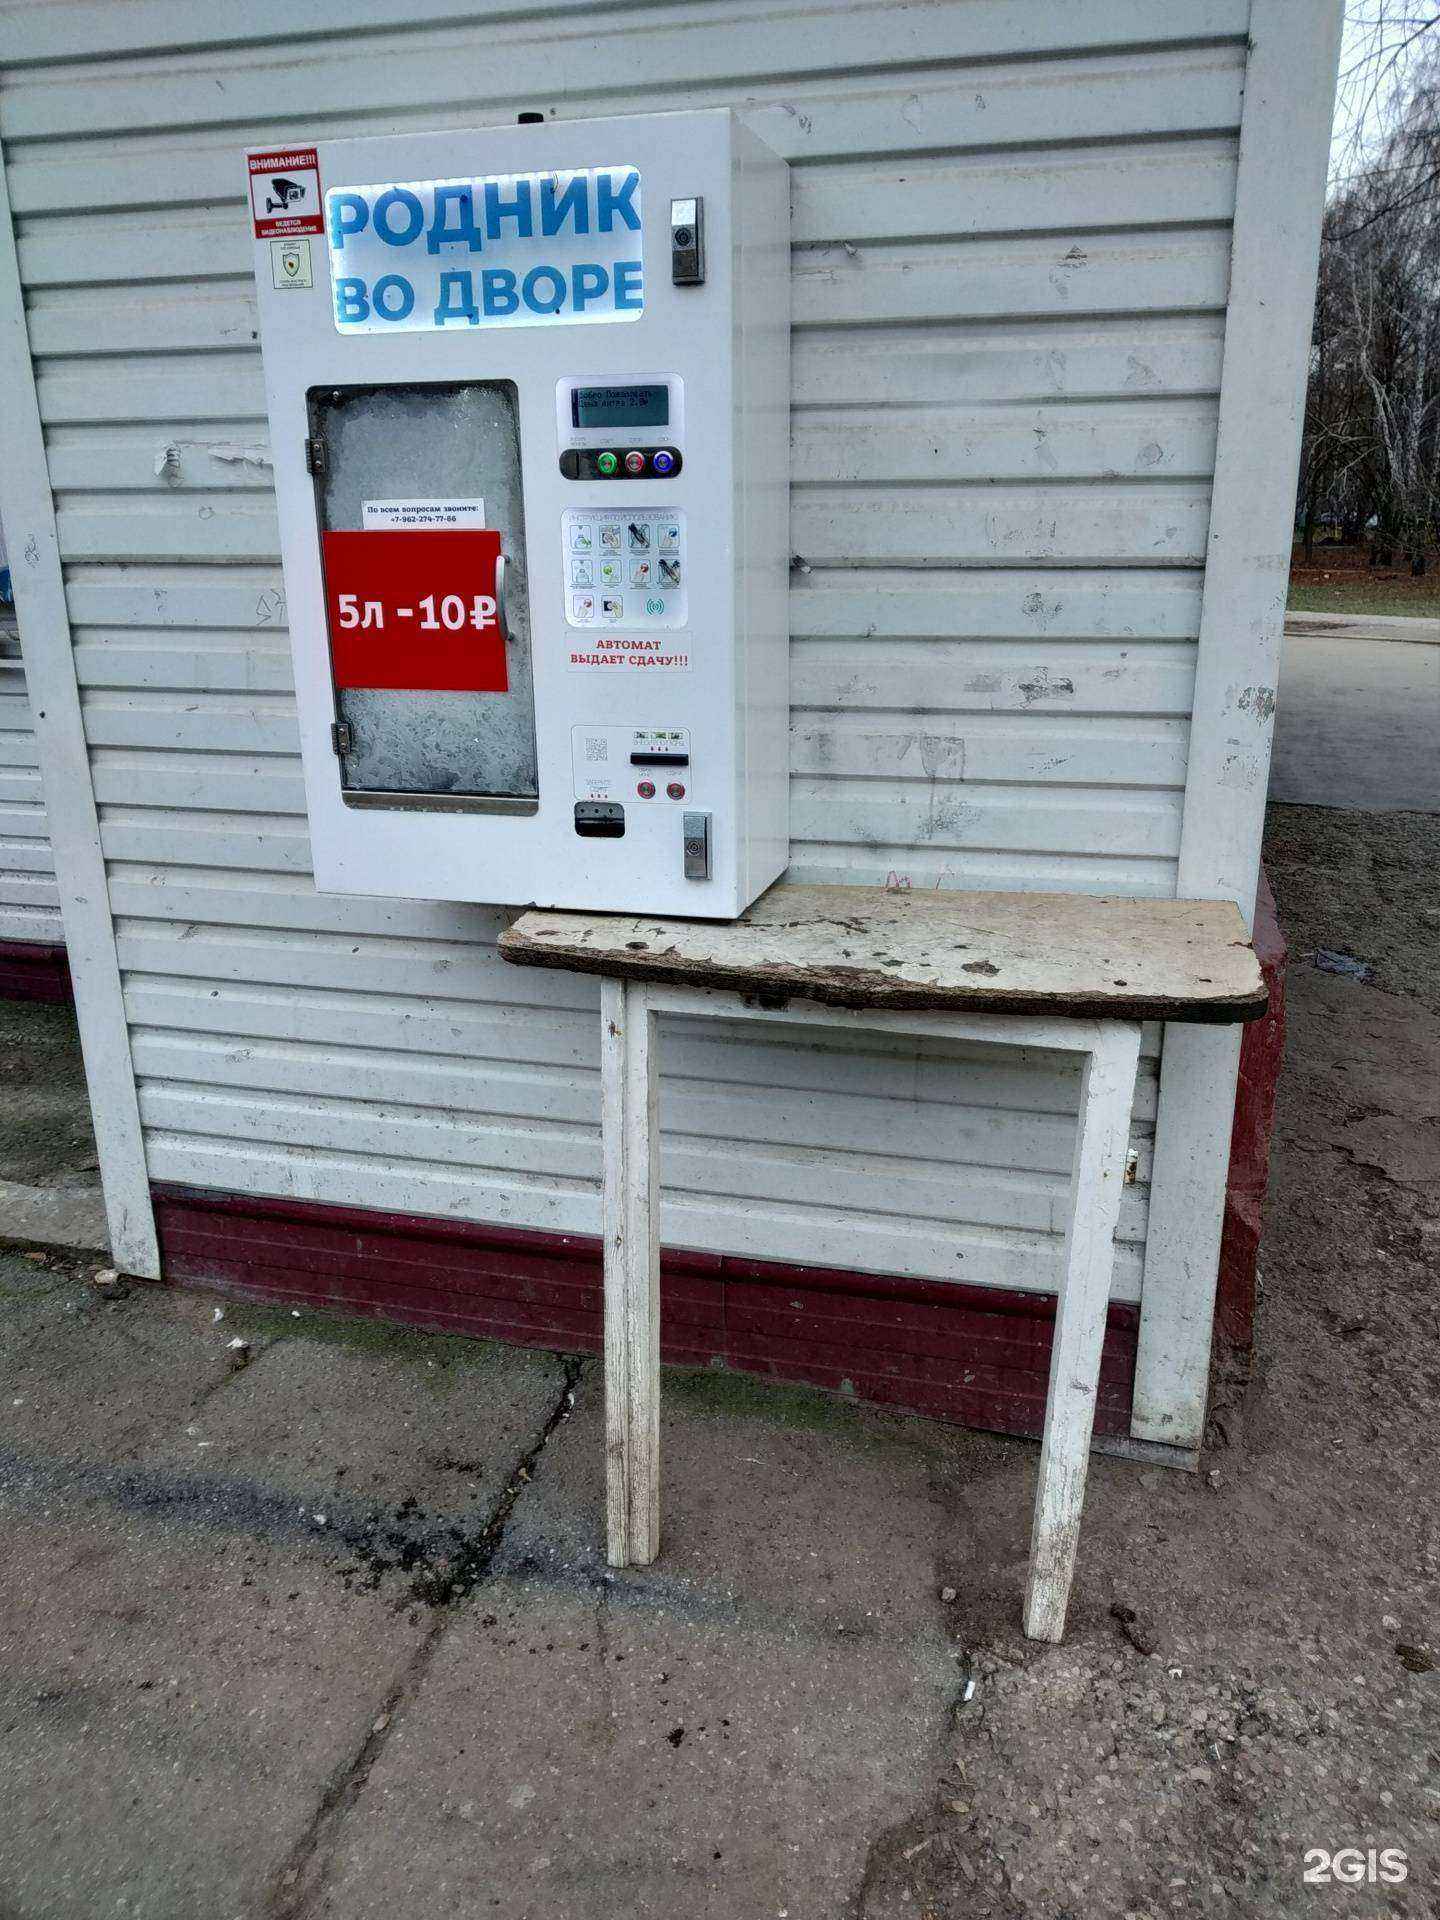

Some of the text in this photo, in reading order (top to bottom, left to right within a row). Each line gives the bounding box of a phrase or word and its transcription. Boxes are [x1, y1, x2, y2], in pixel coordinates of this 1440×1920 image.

[250, 154, 316, 170] ВНИМАНИЕ!!!
[332, 172, 642, 255] РОДНИК
[337, 261, 643, 325] ВО ДВОРЕ
[367, 506, 379, 514] По
[402, 506, 441, 515] вопросам
[338, 594, 384, 629] 5л
[596, 639, 662, 650] АВТОМАТ
[570, 654, 688, 666] ВЫДАЕТ СДАЧУ!!!
